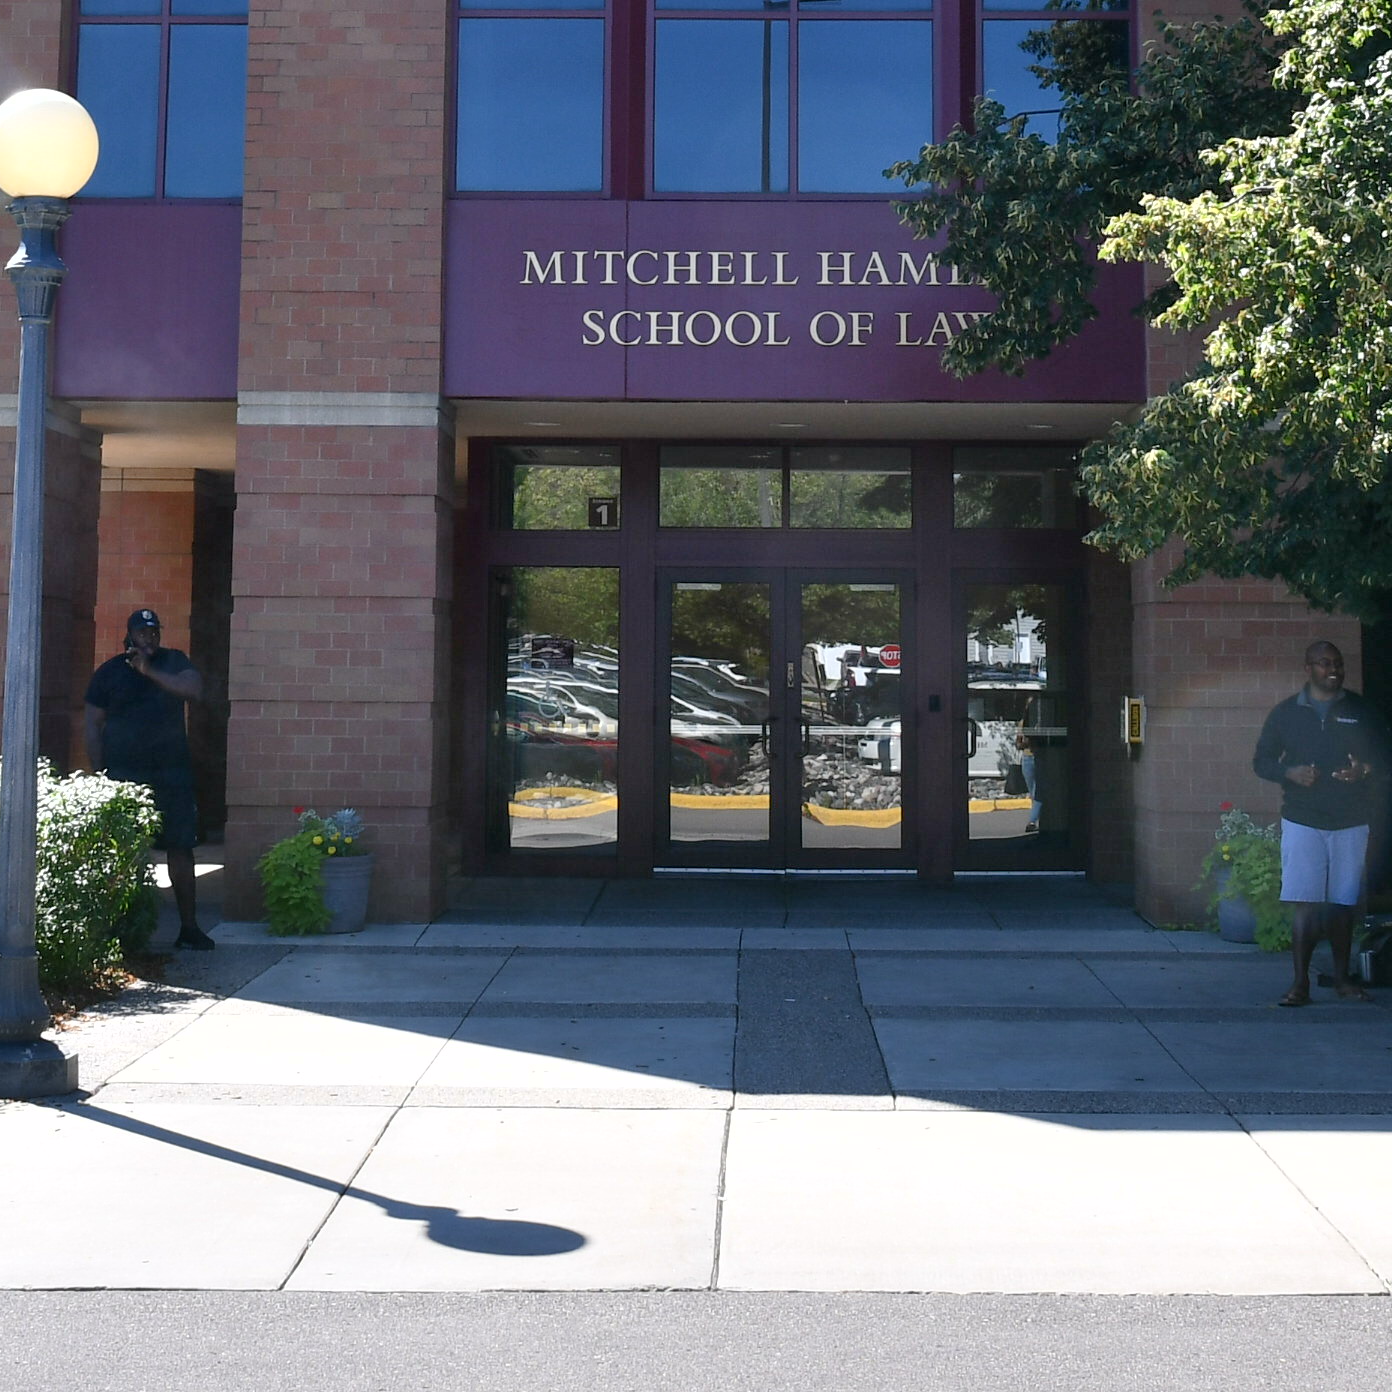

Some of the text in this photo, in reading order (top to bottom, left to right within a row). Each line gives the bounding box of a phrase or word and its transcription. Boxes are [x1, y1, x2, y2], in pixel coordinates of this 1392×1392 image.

[519, 250, 989, 287] MITCHELL HAML
[582, 310, 791, 346] SCHOOL
[809, 310, 874, 346] OF
[596, 504, 608, 525] 1
